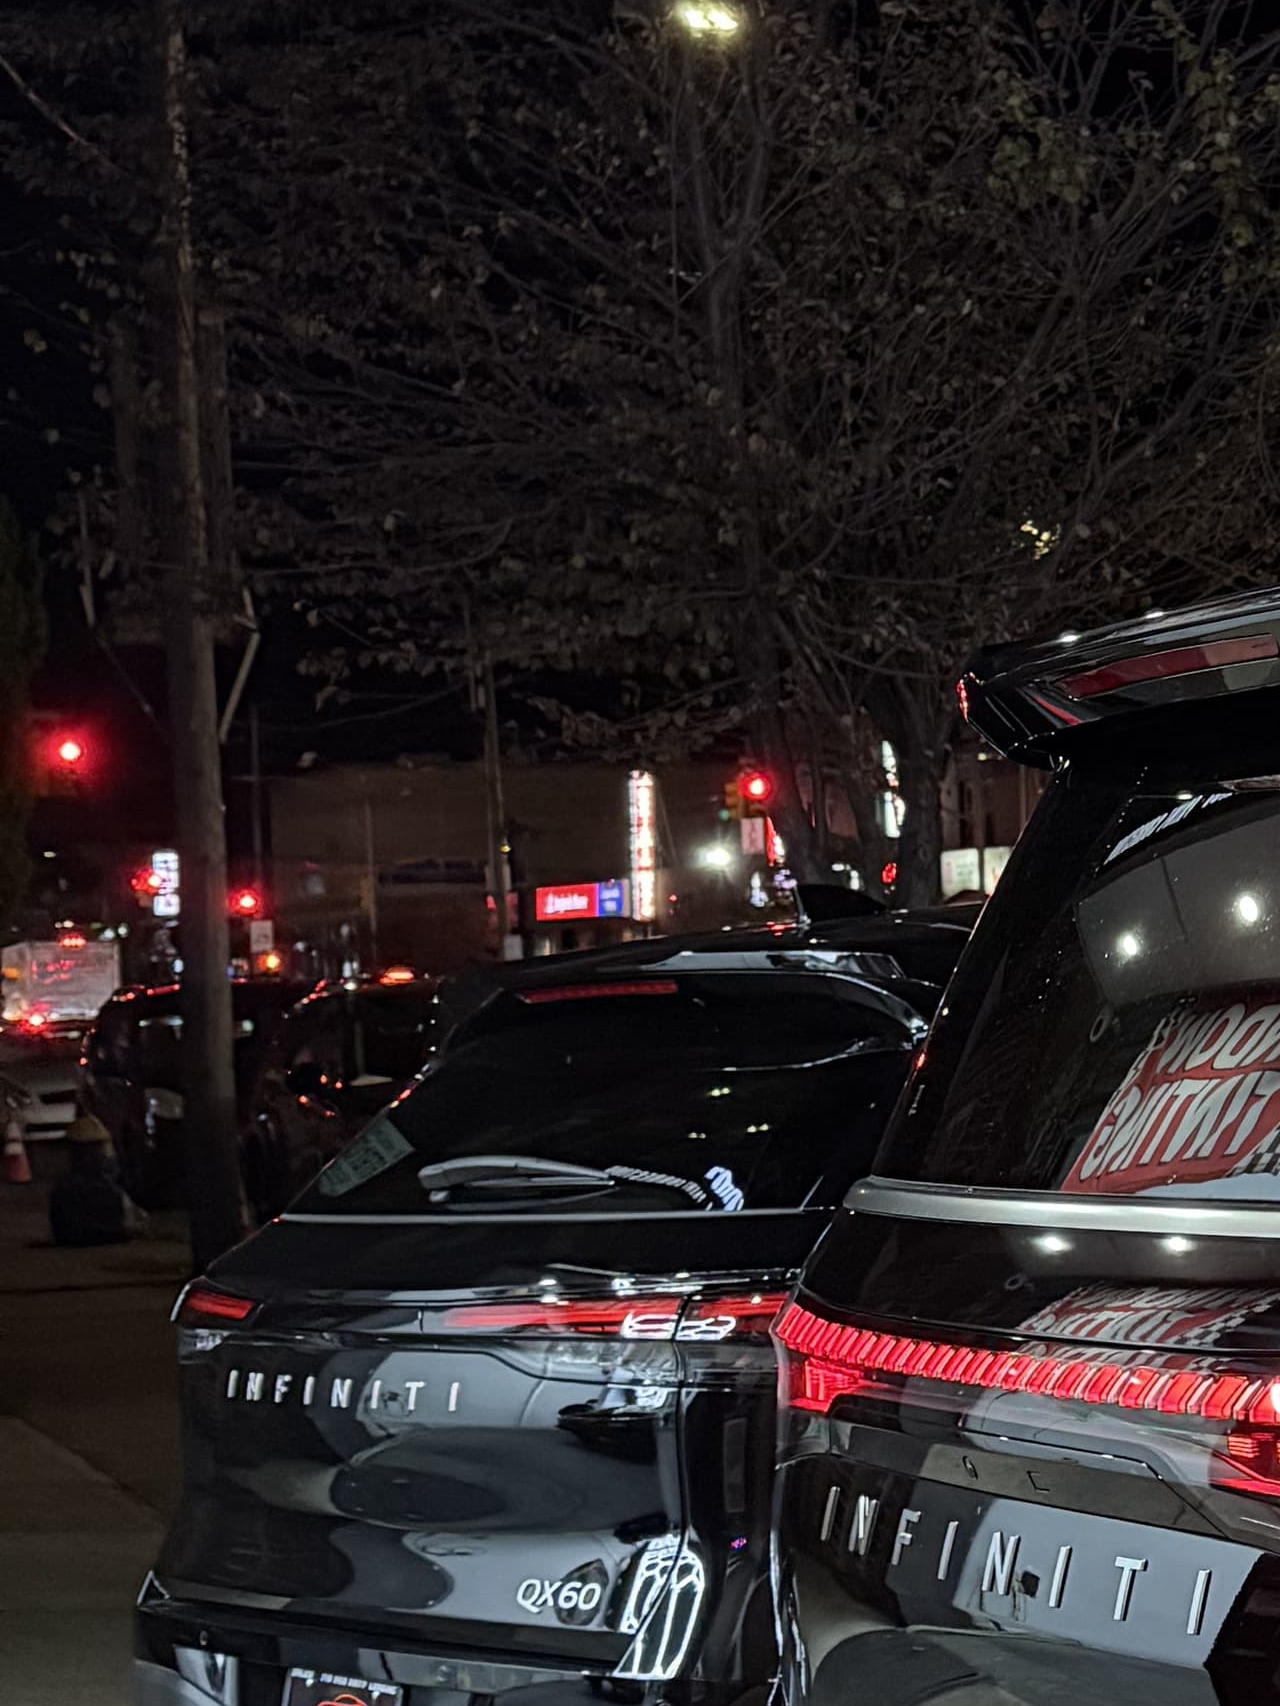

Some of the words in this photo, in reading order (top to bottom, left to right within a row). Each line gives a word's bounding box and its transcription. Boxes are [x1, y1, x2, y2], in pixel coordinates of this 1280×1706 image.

[227, 1369, 460, 1412] INFINITI
[820, 1485, 1214, 1636] INFINITI
[516, 1578, 602, 1614] QX60
